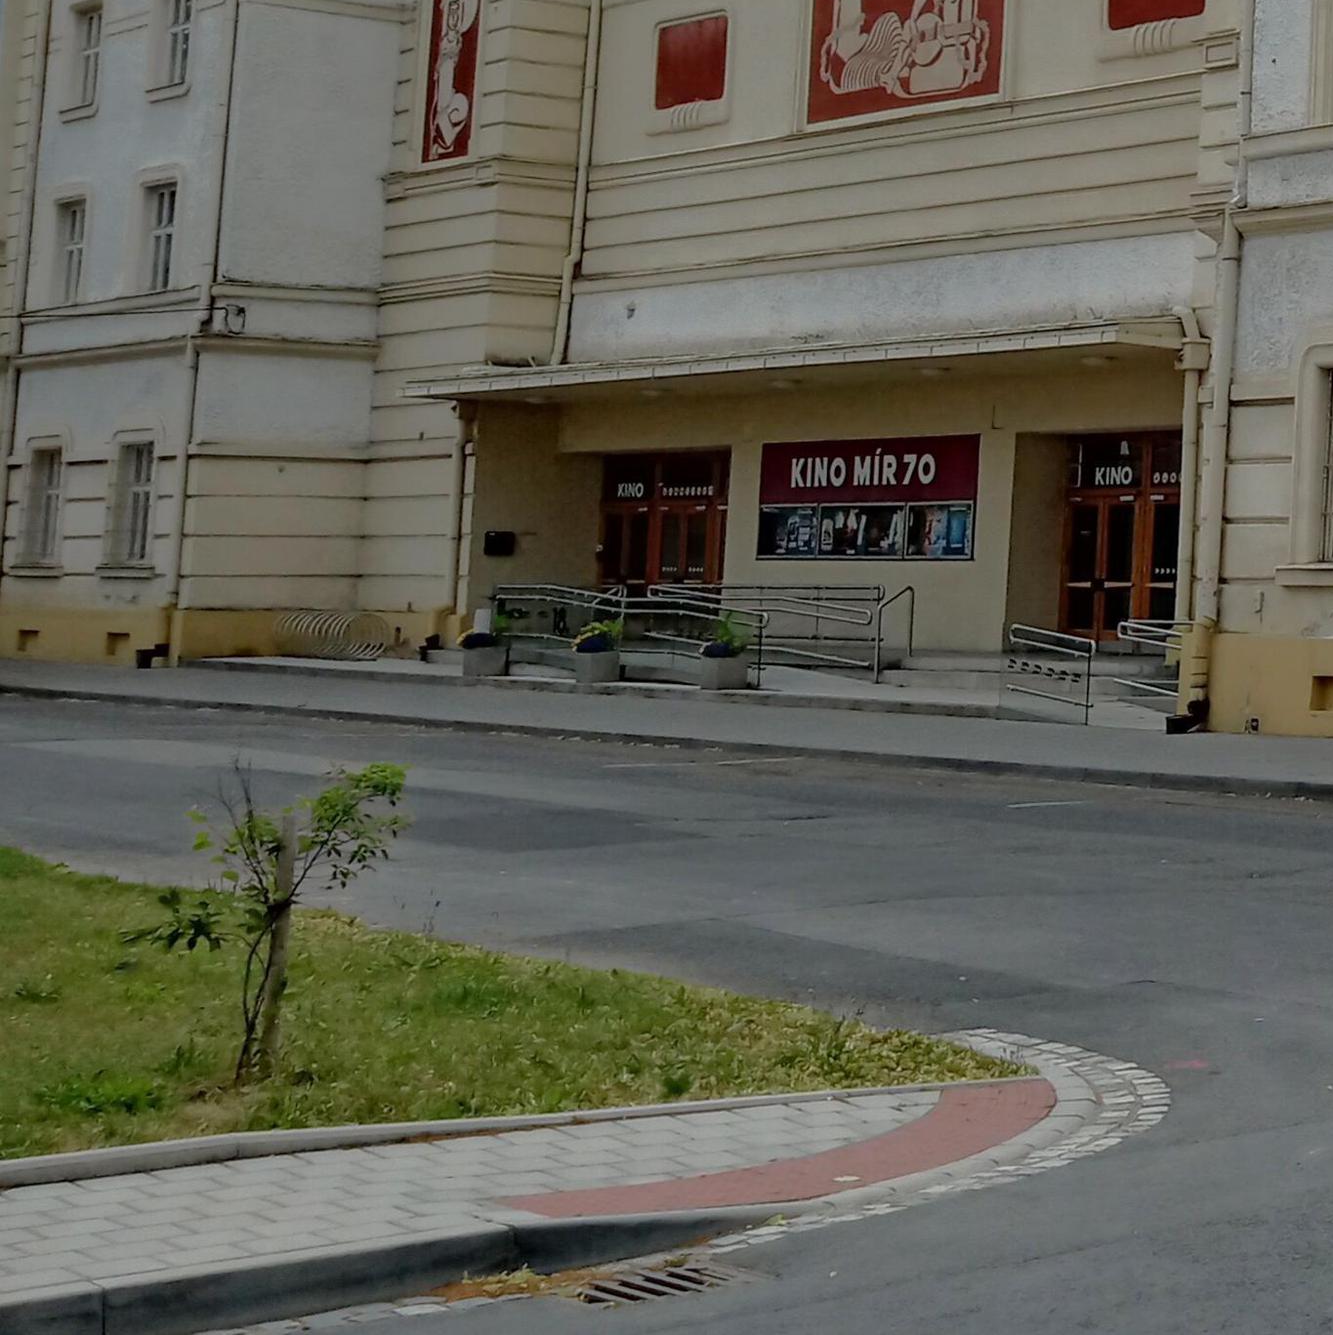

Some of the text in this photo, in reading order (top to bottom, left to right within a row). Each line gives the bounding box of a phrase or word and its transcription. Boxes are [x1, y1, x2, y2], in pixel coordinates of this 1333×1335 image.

[791, 448, 936, 488] KINO MÍR 70
[1095, 466, 1133, 485] KINO
[617, 483, 645, 497] KINO
